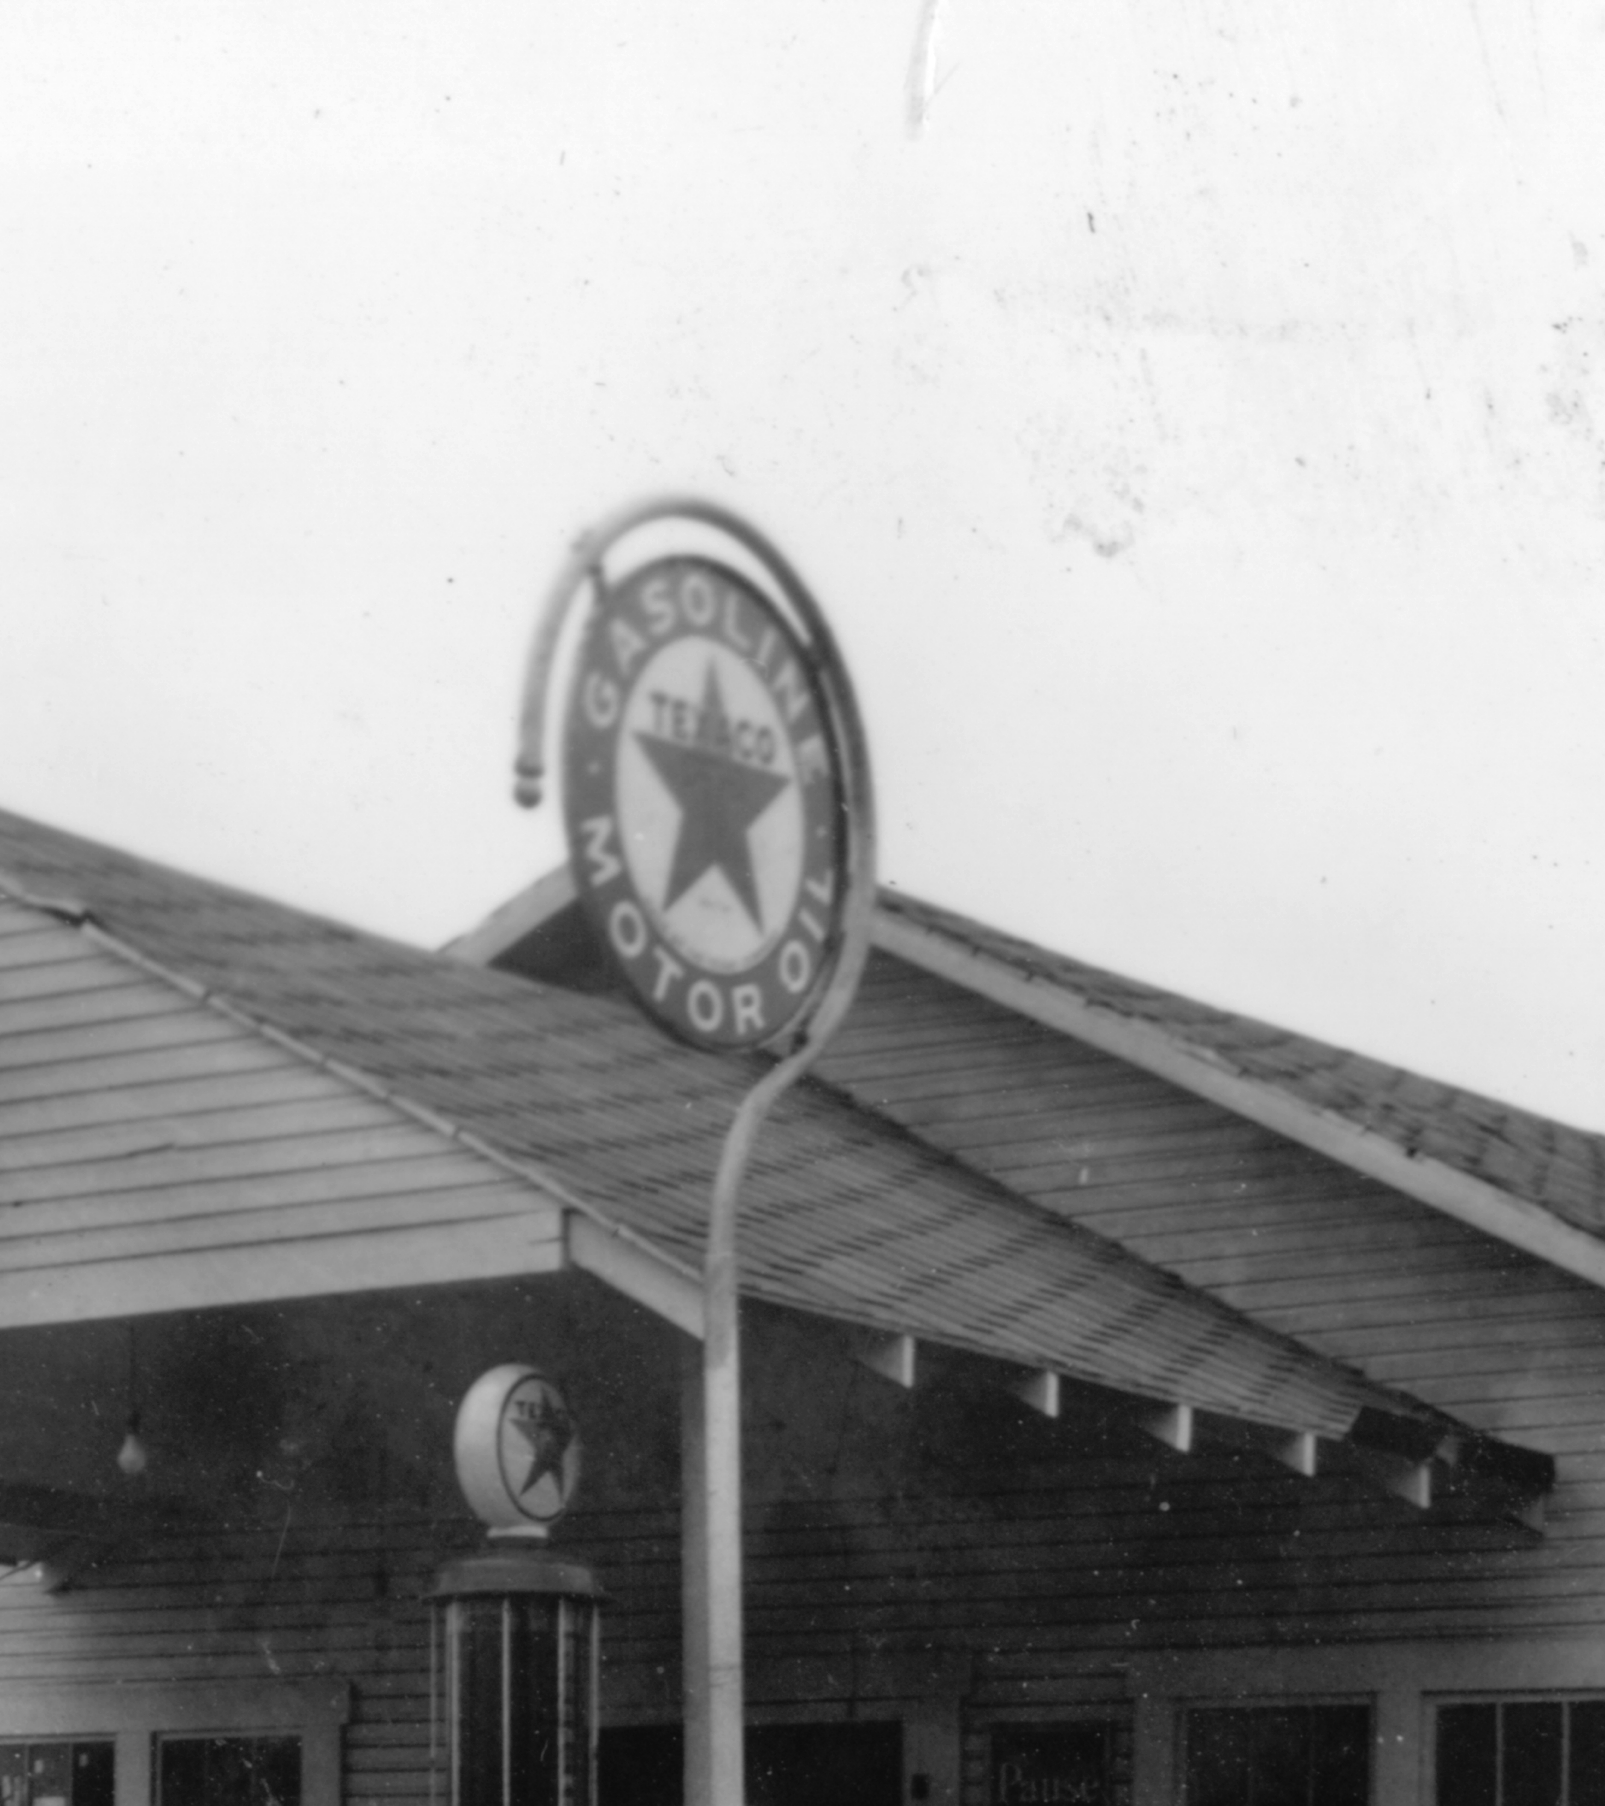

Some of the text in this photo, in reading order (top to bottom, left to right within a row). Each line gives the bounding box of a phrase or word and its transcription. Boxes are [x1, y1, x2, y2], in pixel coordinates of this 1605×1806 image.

[649, 692, 776, 768] TECO
[581, 814, 833, 1035] MOTOR OIL
